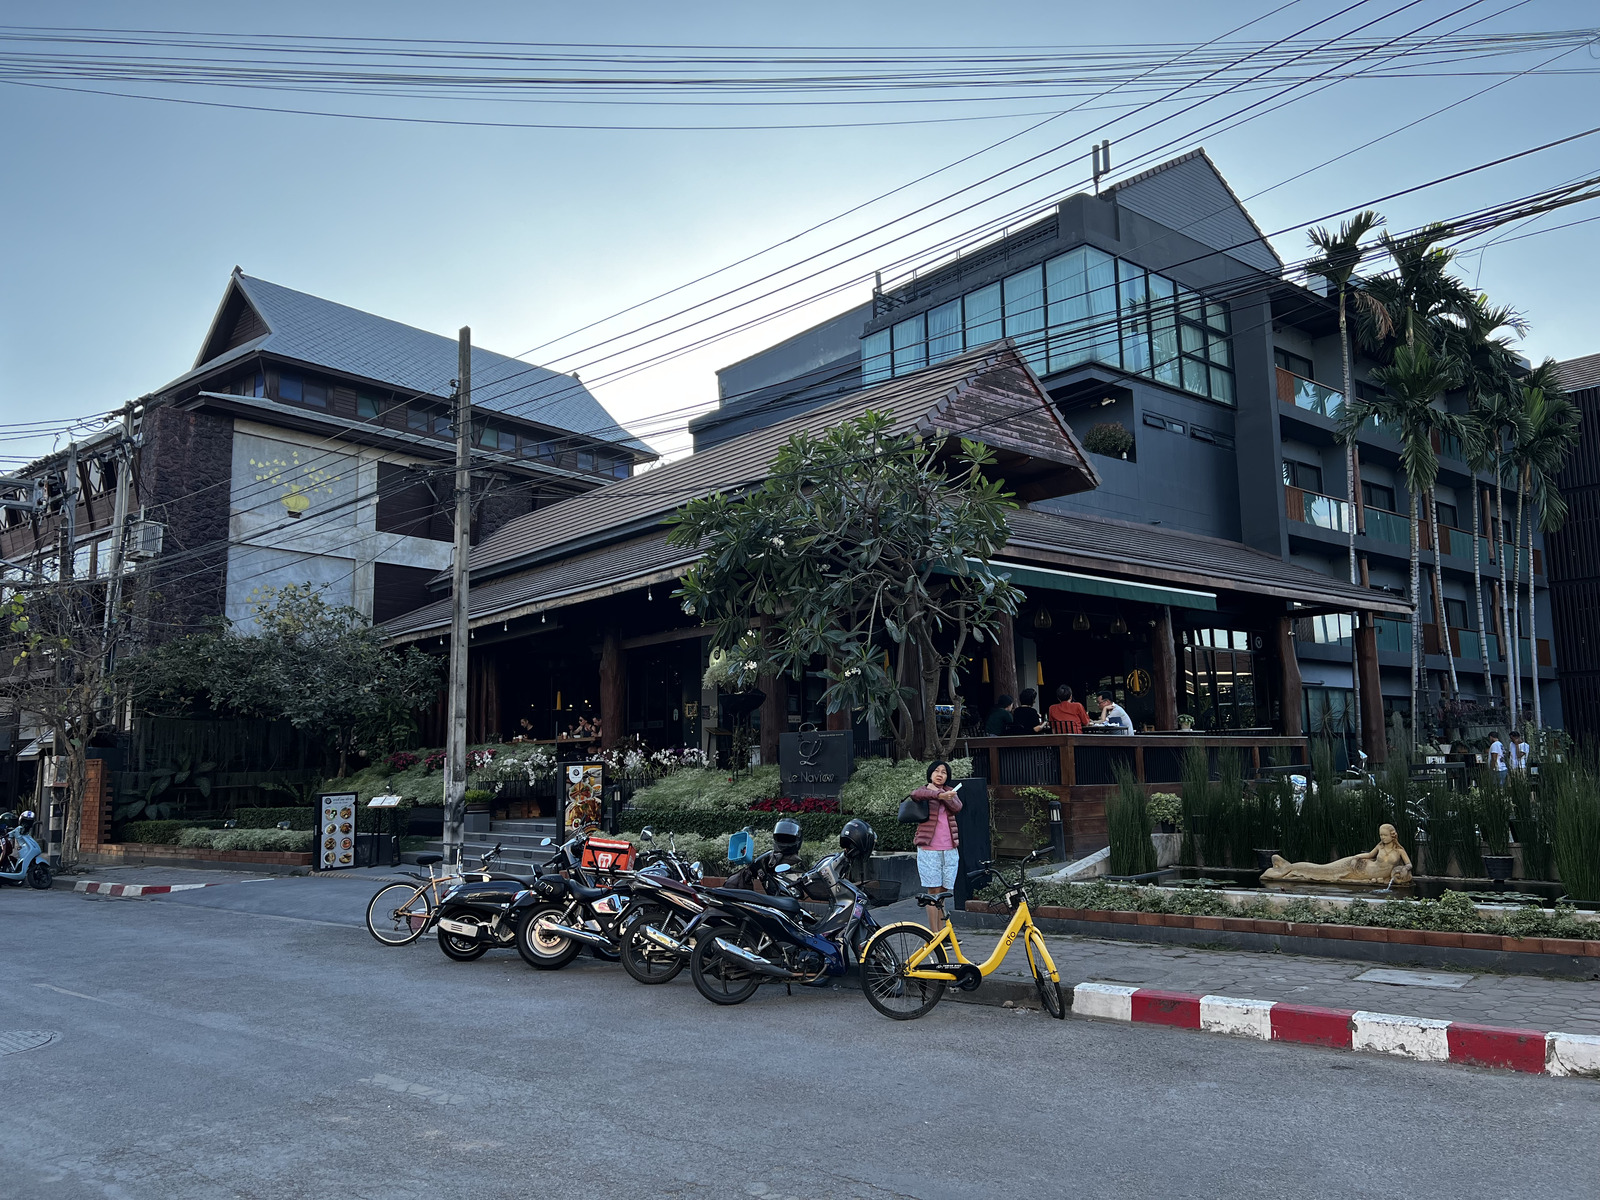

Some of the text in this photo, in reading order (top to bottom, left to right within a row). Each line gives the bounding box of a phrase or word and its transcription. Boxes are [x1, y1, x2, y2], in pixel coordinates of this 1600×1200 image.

[788, 770, 835, 782] Le Naview
[1006, 931, 1016, 946] ofo
